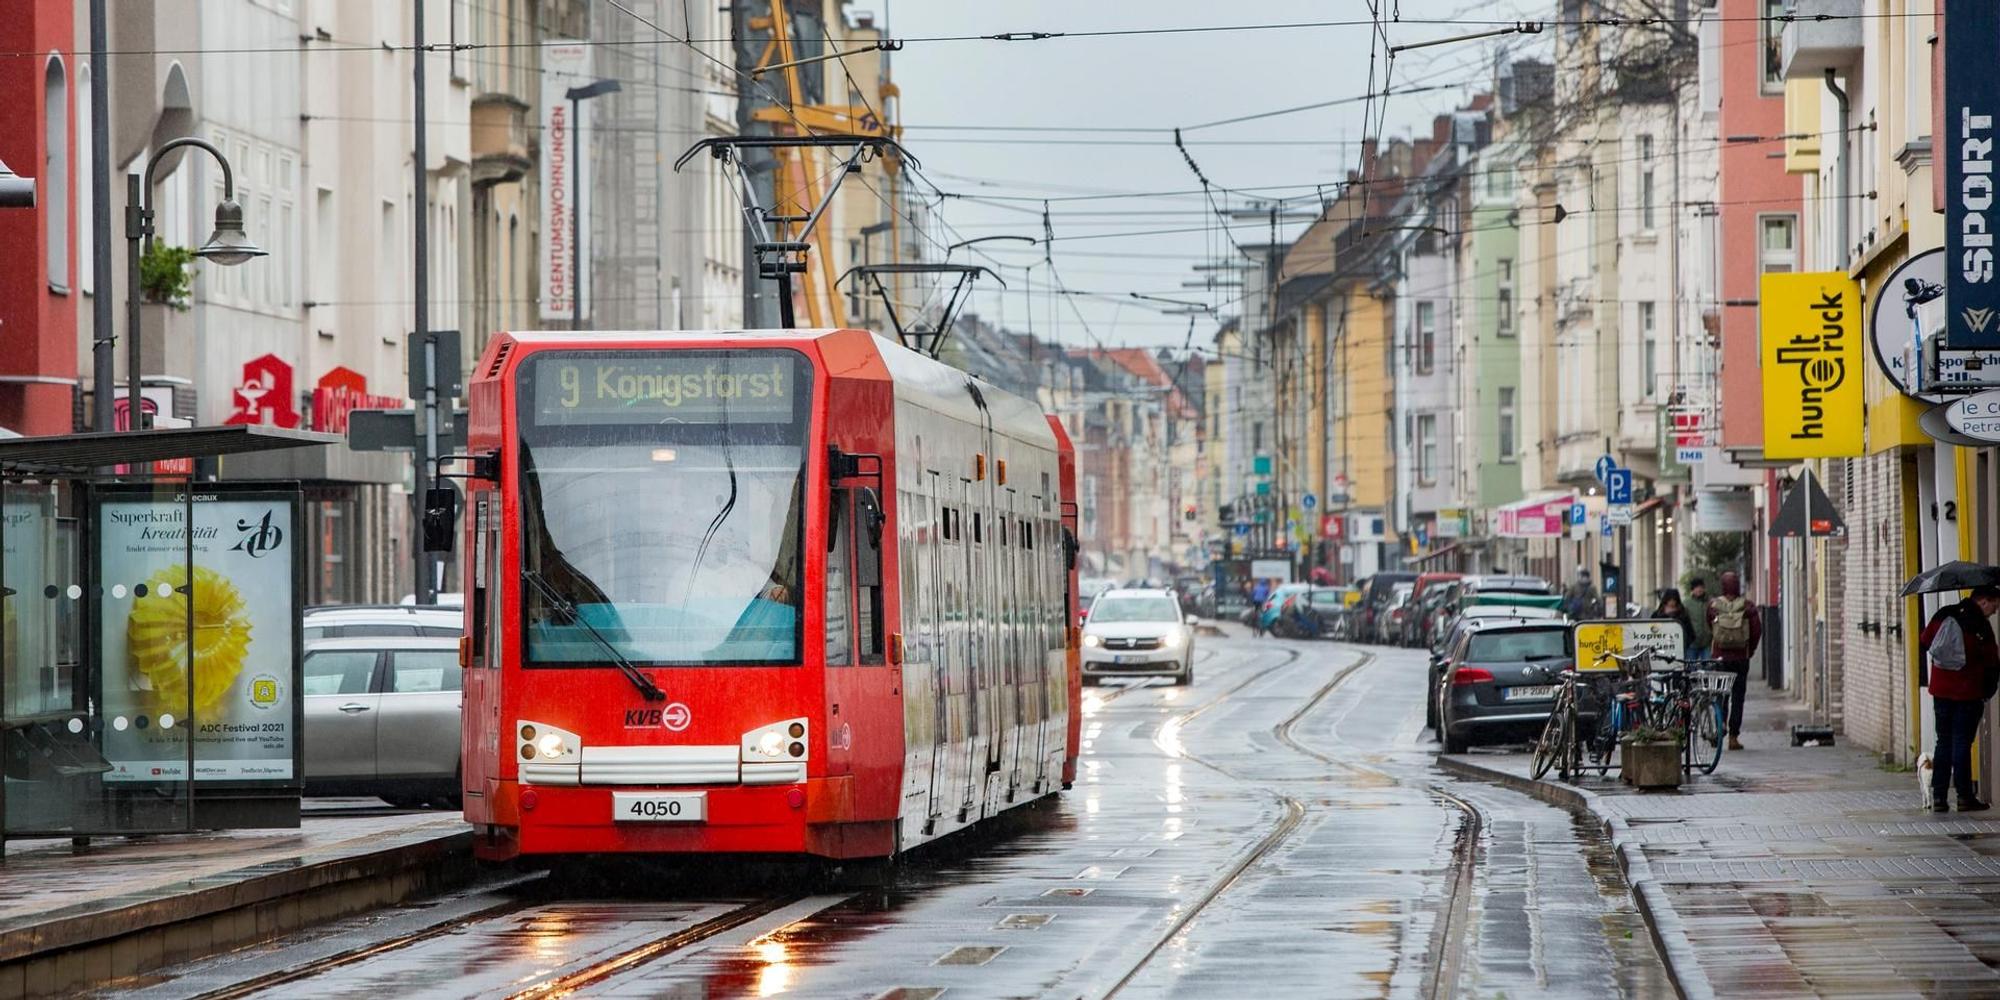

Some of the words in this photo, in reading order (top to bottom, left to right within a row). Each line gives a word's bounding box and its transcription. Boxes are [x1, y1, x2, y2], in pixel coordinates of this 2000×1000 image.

[1962, 106, 1993, 283] SPORT
[550, 105, 565, 311] EIGENTUMSWOHNUNGEN
[560, 366, 580, 408] 9
[597, 364, 784, 407] Königsforst
[1962, 401, 1978, 415] le
[1987, 402, 2000, 413] c
[1610, 473, 1624, 500] P
[174, 494, 218, 502] JCecaux
[110, 509, 184, 526] Superkraft
[1573, 506, 1583, 523] P
[141, 526, 218, 540] Kreatiität
[625, 709, 661, 726] KVB
[200, 724, 221, 733] ADC
[223, 723, 259, 732] Festival
[262, 723, 285, 732] 2021
[631, 801, 681, 816] 4050
